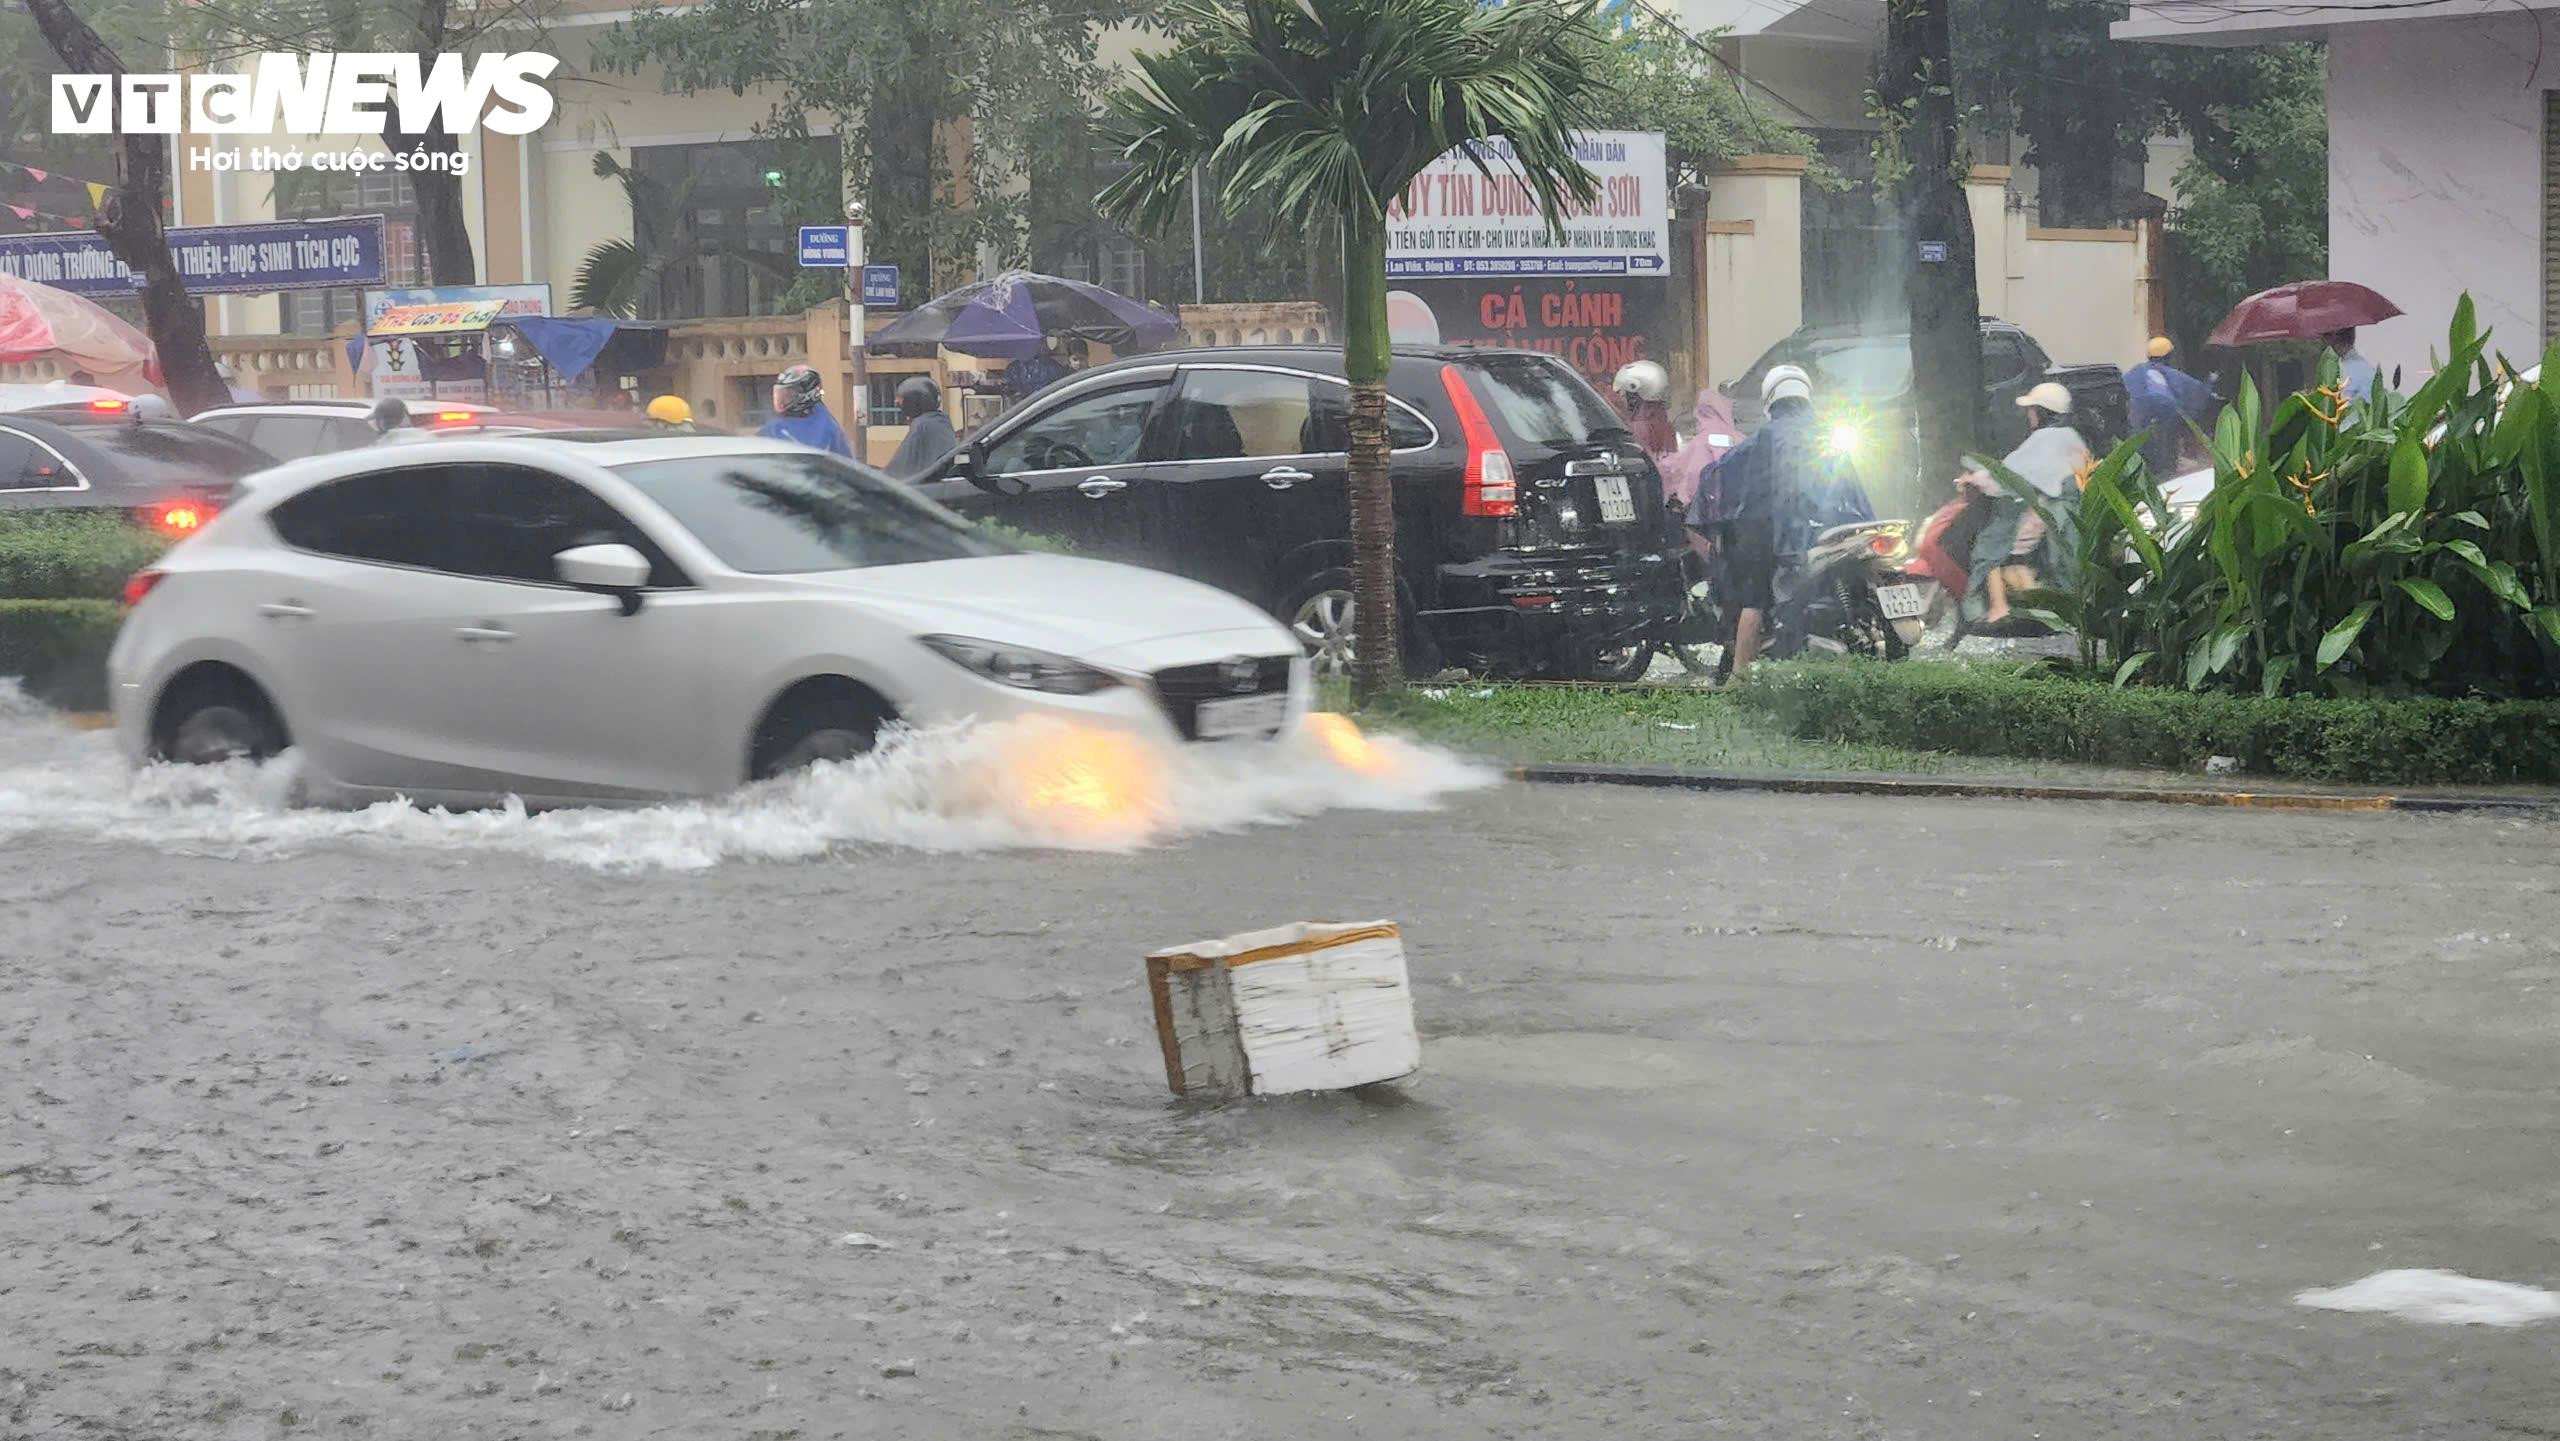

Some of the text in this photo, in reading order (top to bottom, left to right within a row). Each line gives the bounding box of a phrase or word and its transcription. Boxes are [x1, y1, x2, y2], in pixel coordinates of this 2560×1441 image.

[1437, 164, 1474, 217] TÍN
[1480, 173, 1534, 225] DỤNG
[1607, 172, 1641, 218] SƠN
[63, 243, 115, 280] TRƯỜNG
[259, 241, 293, 272] SINH
[295, 233, 329, 270] TÍCH
[332, 234, 360, 273] CỰC
[1479, 280, 1623, 329] CÁ CẢNH
